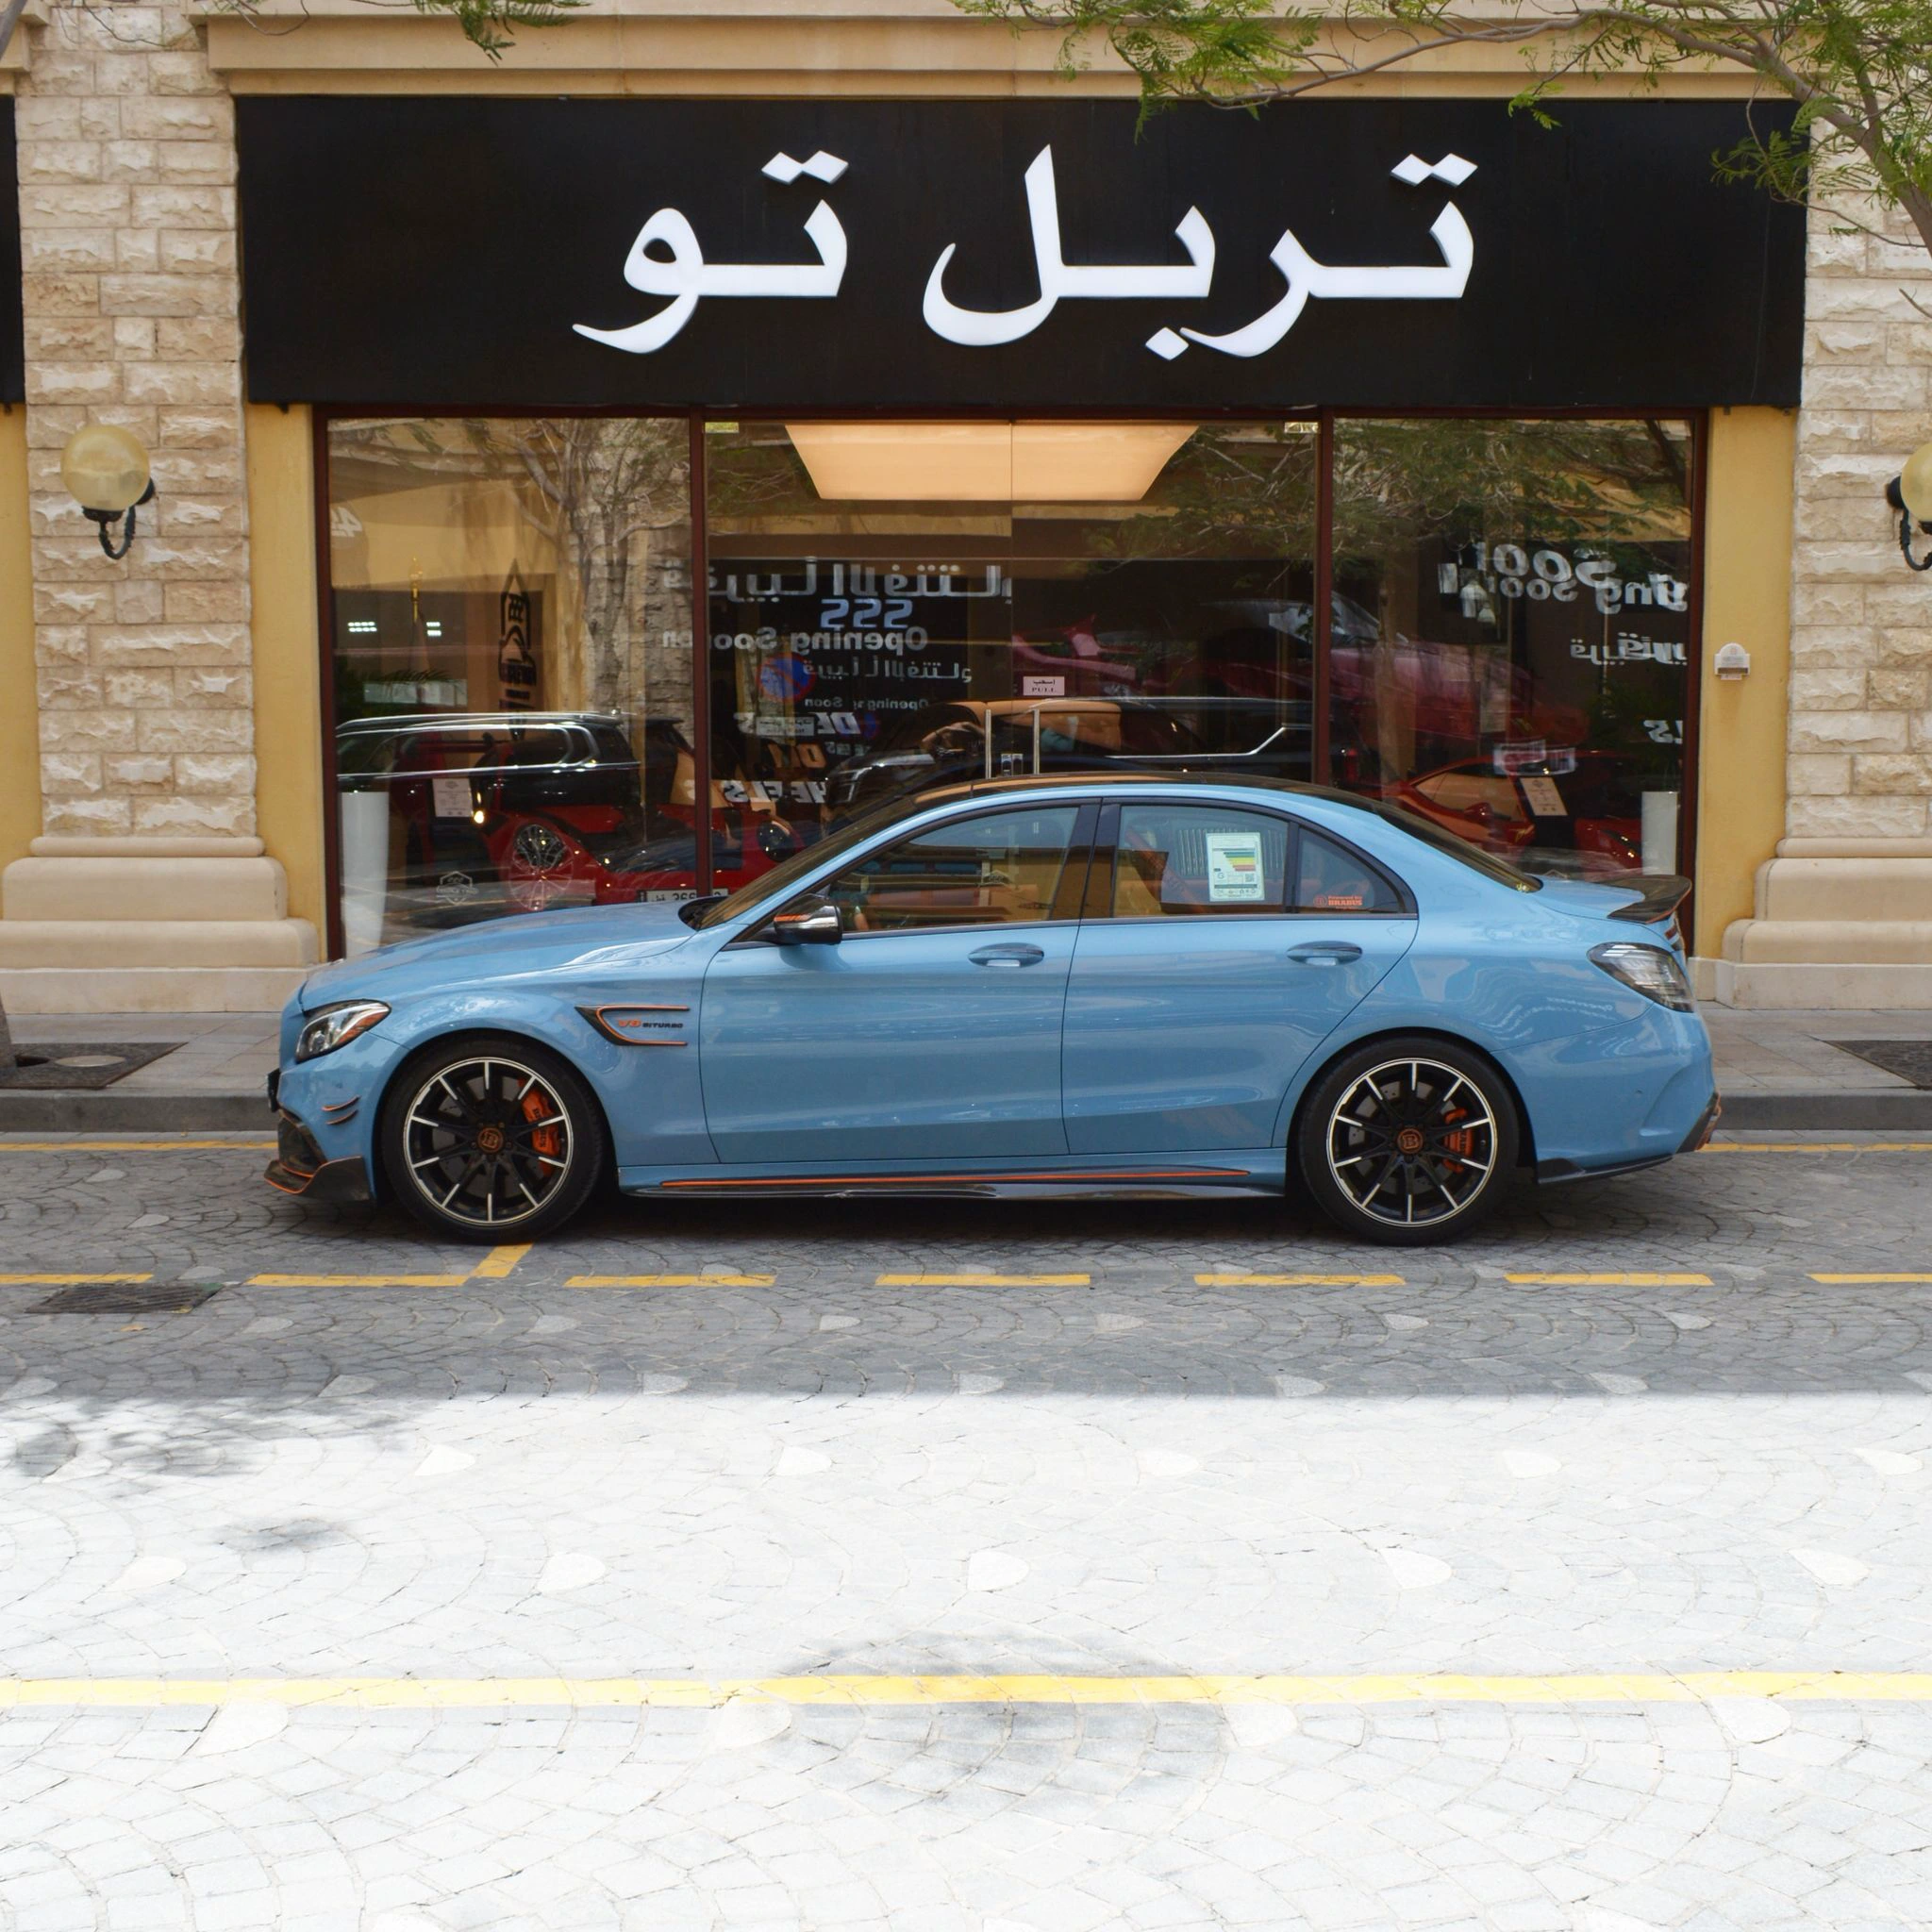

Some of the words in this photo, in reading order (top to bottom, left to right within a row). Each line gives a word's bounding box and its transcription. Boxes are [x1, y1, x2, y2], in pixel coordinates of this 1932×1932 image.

[572, 149, 849, 356] تو
[920, 143, 1477, 361] تربل
[618, 1018, 642, 1028] V8
